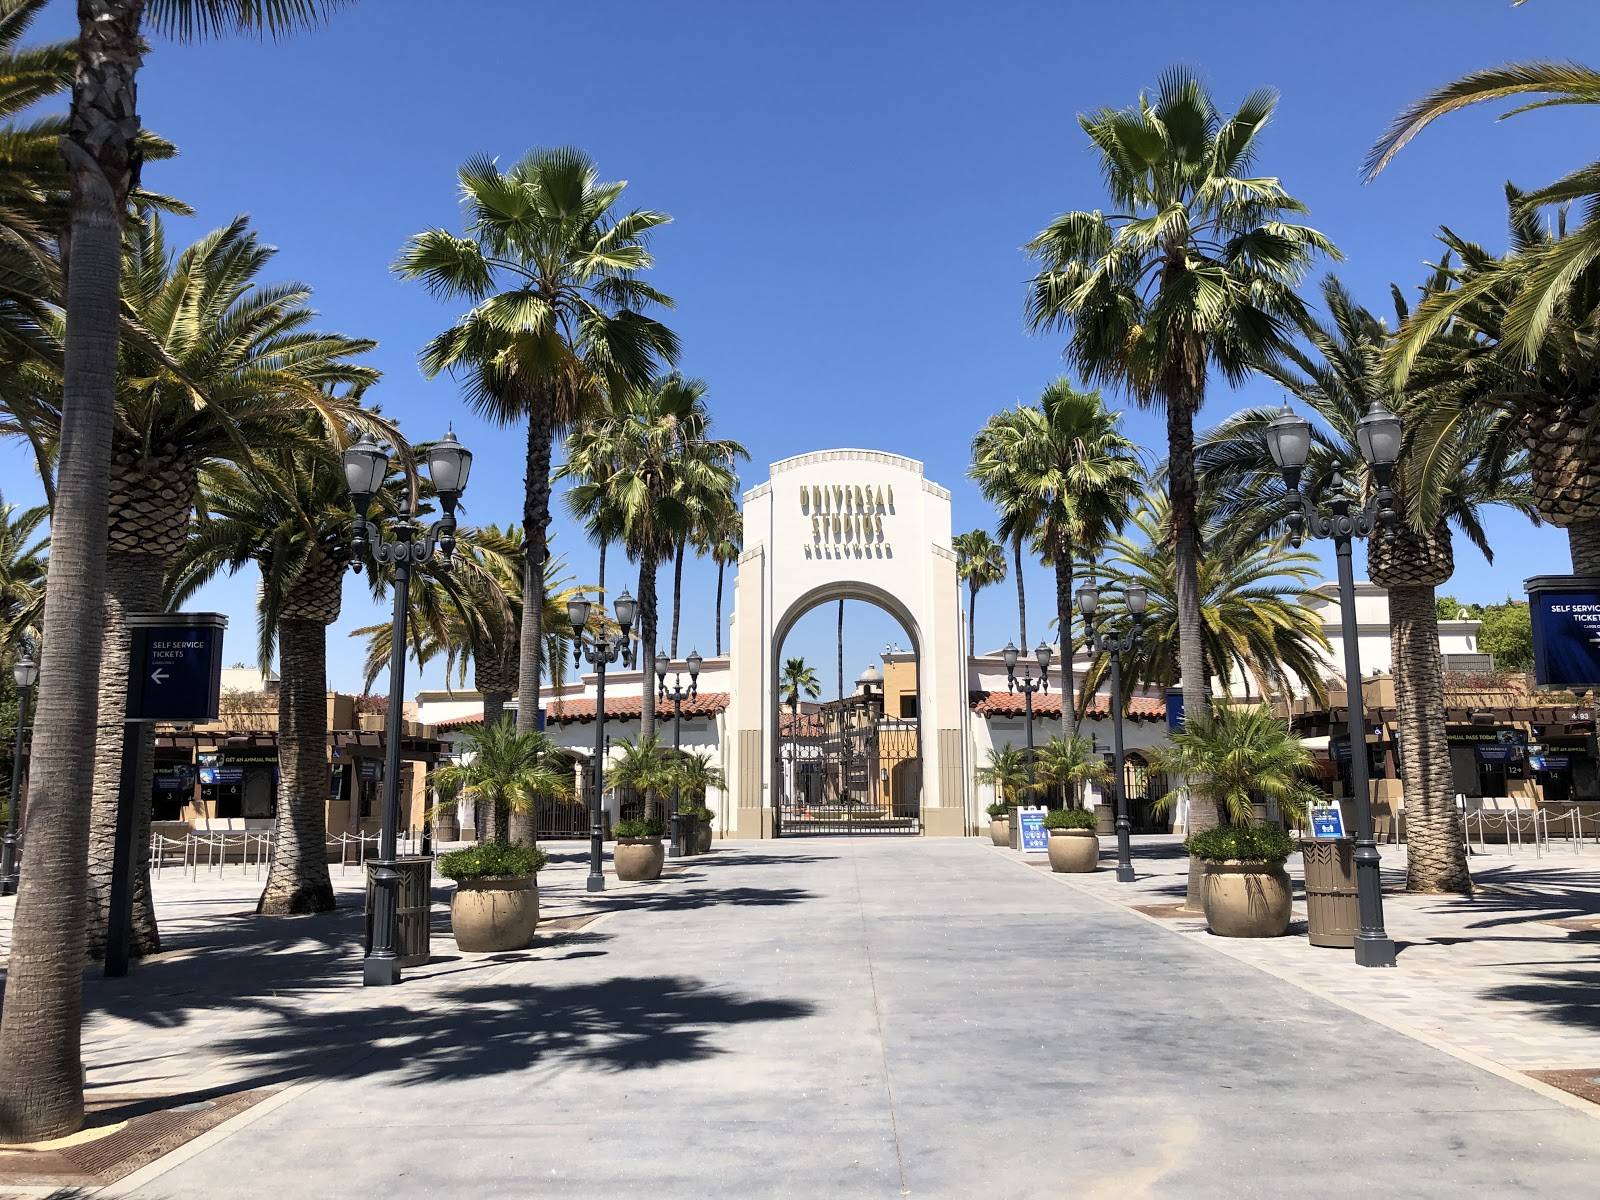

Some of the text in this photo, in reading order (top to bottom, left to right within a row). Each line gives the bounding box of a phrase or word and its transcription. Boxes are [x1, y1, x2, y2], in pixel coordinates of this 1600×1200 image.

[800, 484, 894, 508] UNIVERSAL
[812, 512, 884, 537] STUDIOS
[804, 543, 893, 559] HOLLYWOOD
[1551, 605, 1571, 613] SELF
[153, 641, 205, 649] SELF SERVICE
[1484, 763, 1492, 772] 11
[1508, 766, 1517, 774] 12
[230, 786, 237, 794] 6
[166, 792, 173, 800] 3
